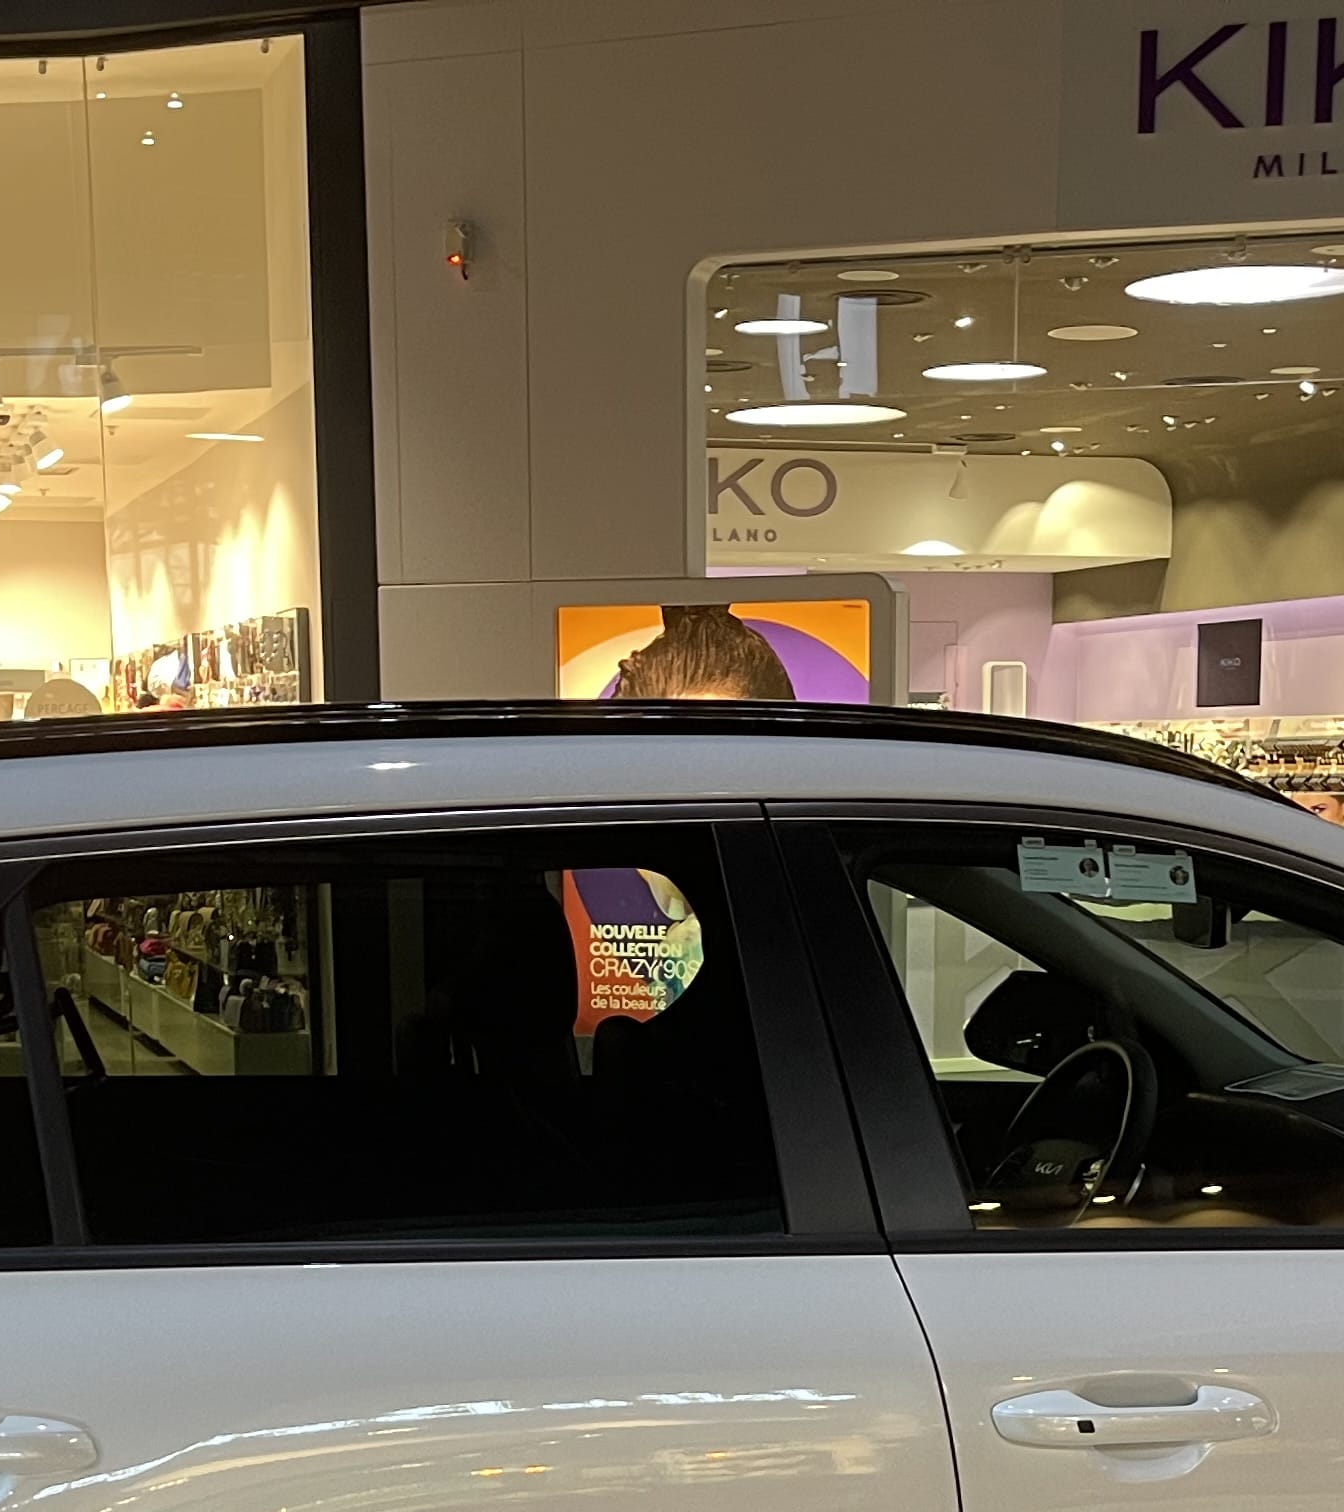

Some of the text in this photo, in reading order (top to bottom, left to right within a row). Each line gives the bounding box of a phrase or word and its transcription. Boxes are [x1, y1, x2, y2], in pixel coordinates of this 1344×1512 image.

[707, 457, 838, 518] KO
[712, 527, 778, 542] LANO
[590, 924, 667, 939] NOUVELLE
[589, 941, 682, 957] COLLECTION
[590, 958, 658, 978] CRAZY
[591, 981, 666, 996] Les couleurs
[591, 995, 666, 1011] de la beauté
